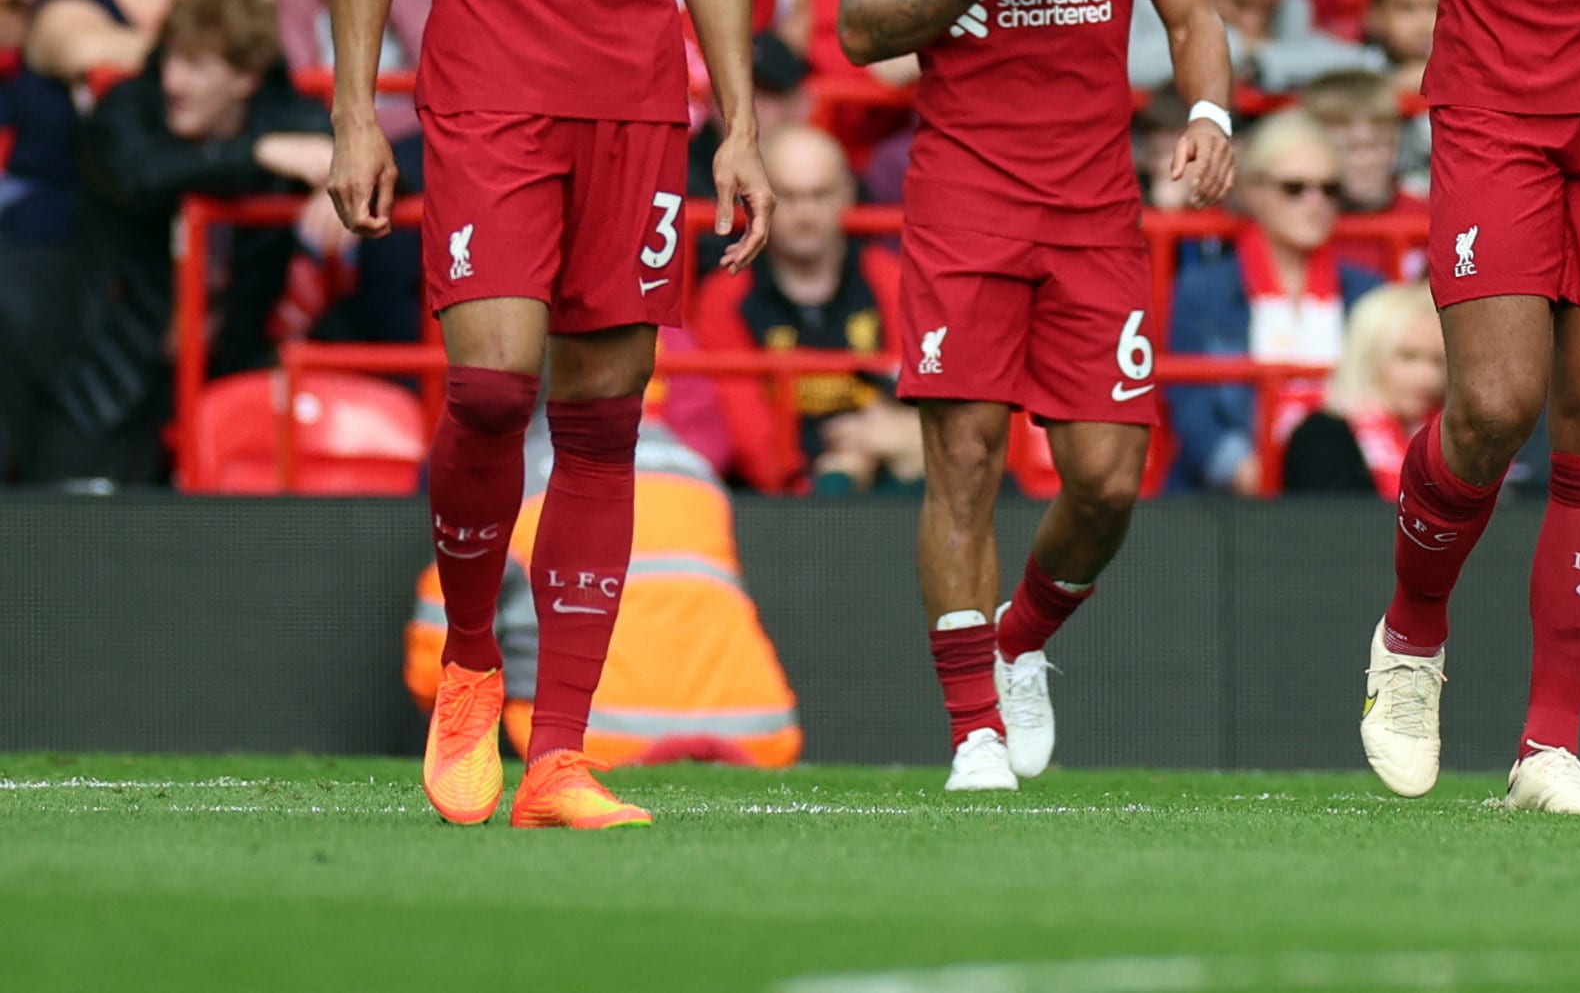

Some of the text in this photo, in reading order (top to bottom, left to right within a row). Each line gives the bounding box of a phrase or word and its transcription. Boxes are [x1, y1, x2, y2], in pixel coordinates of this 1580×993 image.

[997, 1, 1112, 28] chartered
[640, 191, 683, 269] 3
[1116, 310, 1154, 381] 6
